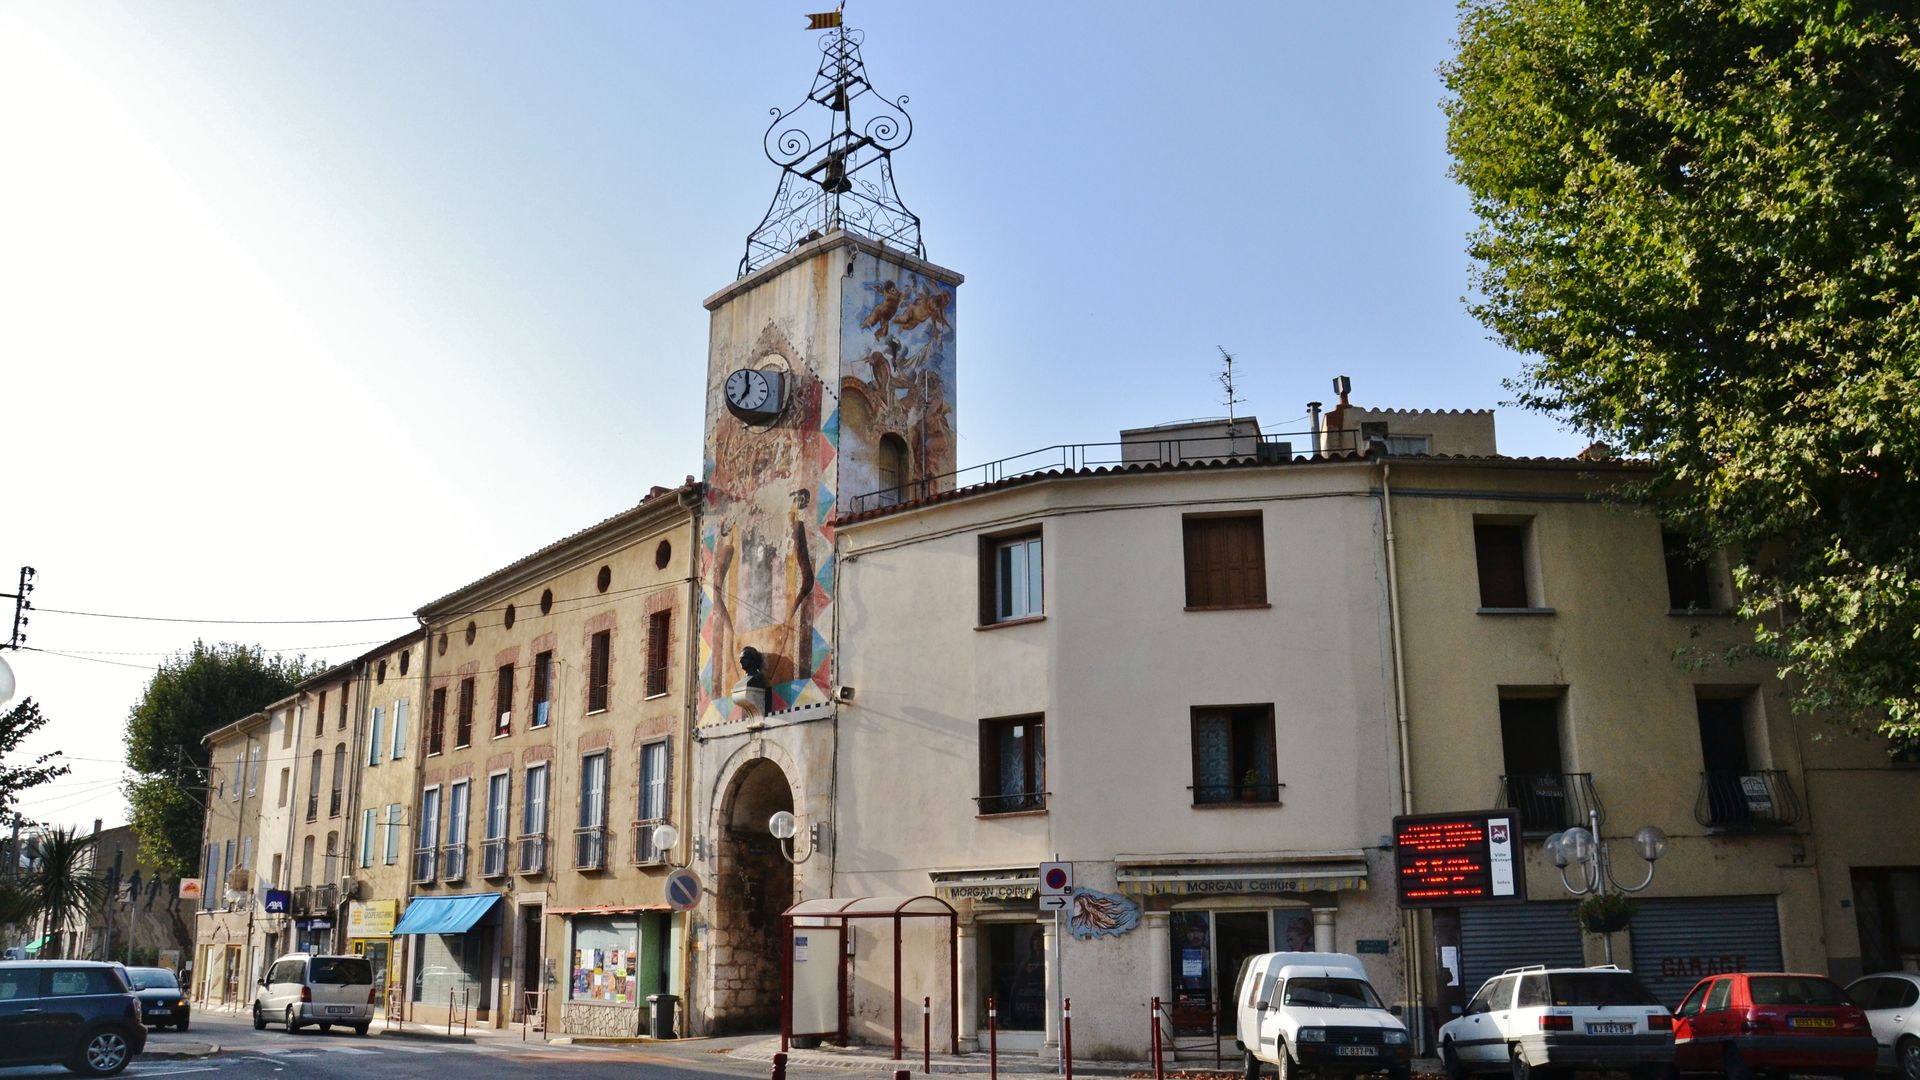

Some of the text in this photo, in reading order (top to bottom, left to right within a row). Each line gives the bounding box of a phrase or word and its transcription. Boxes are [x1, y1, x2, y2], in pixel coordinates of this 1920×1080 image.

[951, 885, 1036, 898] MORGAN Coiffure
[1187, 879, 1297, 892] MORGAN Coiffure
[265, 901, 283, 910] AXA
[1662, 956, 1745, 976] GARAGE
